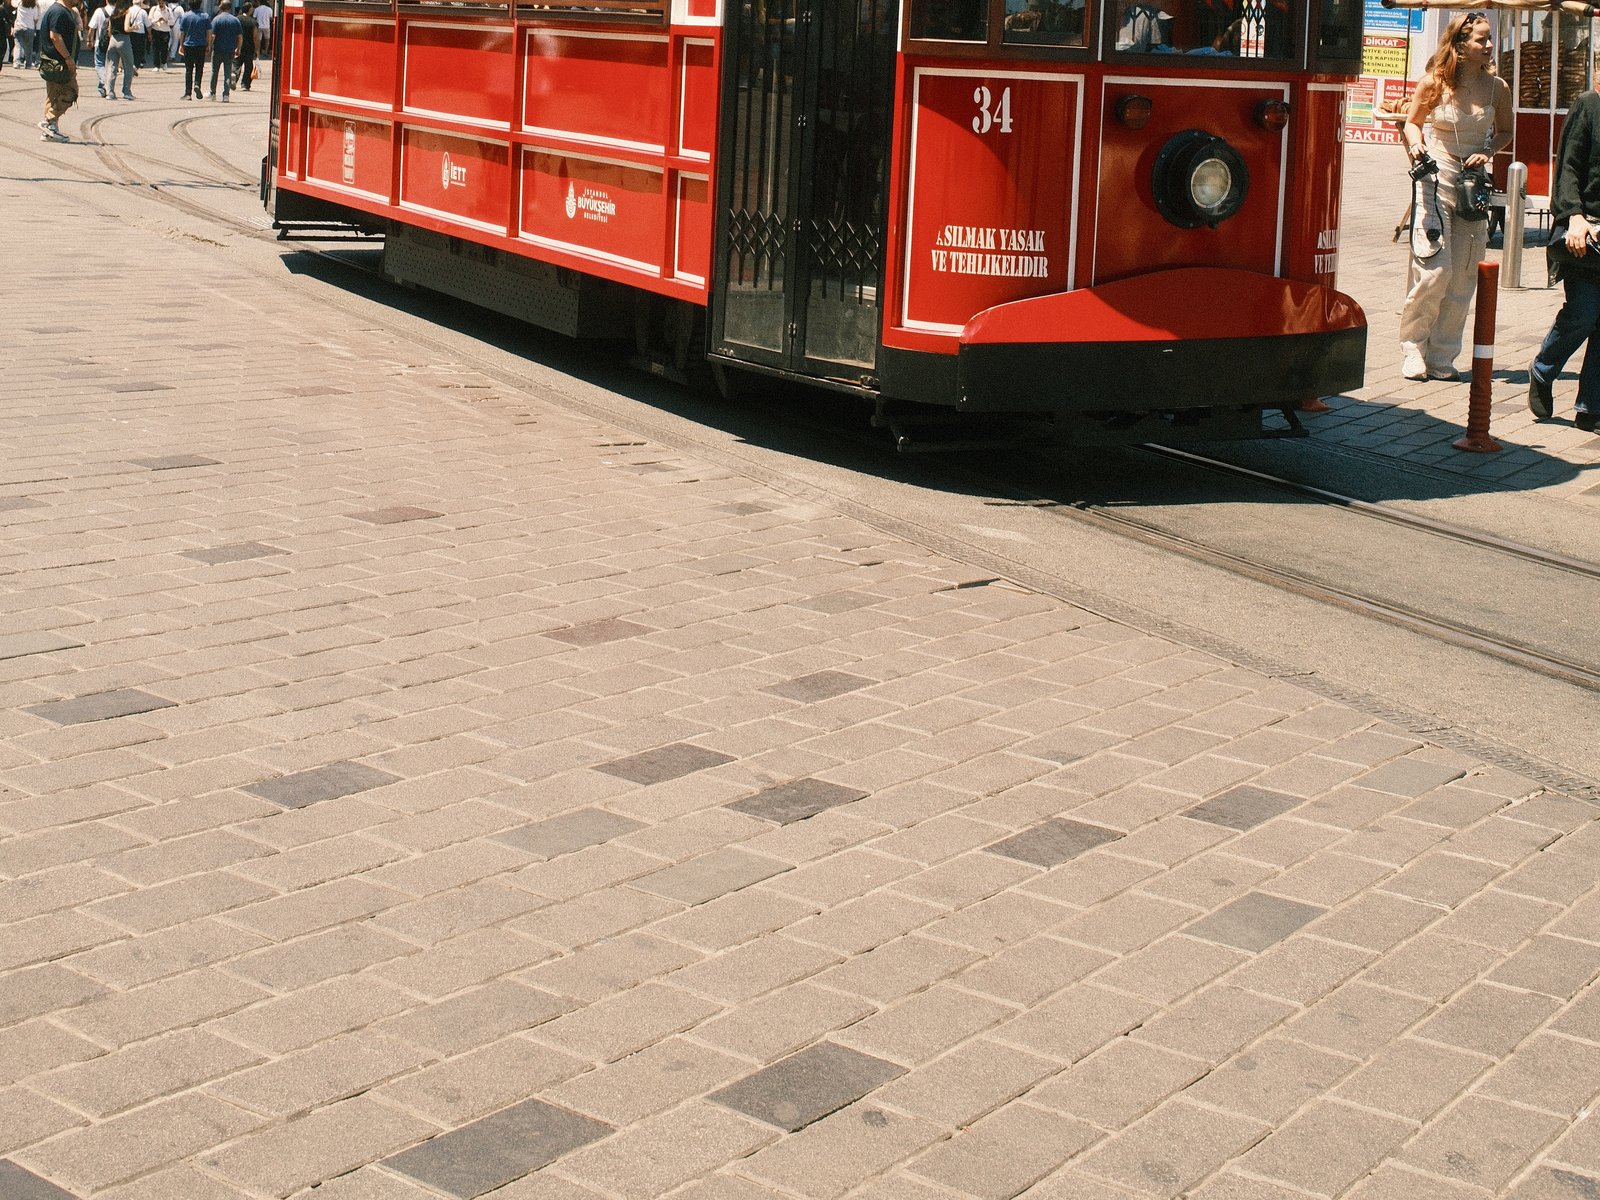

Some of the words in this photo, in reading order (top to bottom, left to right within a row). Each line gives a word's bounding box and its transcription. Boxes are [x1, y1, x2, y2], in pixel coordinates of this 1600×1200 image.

[1366, 37, 1398, 47] DİKKAT
[972, 86, 1013, 133] 34
[1345, 130, 1394, 142] SAKTIR
[451, 162, 467, 182] İETT
[577, 194, 616, 216] BÜYÜKŞEHİR
[936, 225, 996, 249] ASILMAK
[1000, 229, 1045, 252] YASAK
[931, 250, 946, 272] VE
[949, 251, 1048, 278] TEHLIKELIDIR
